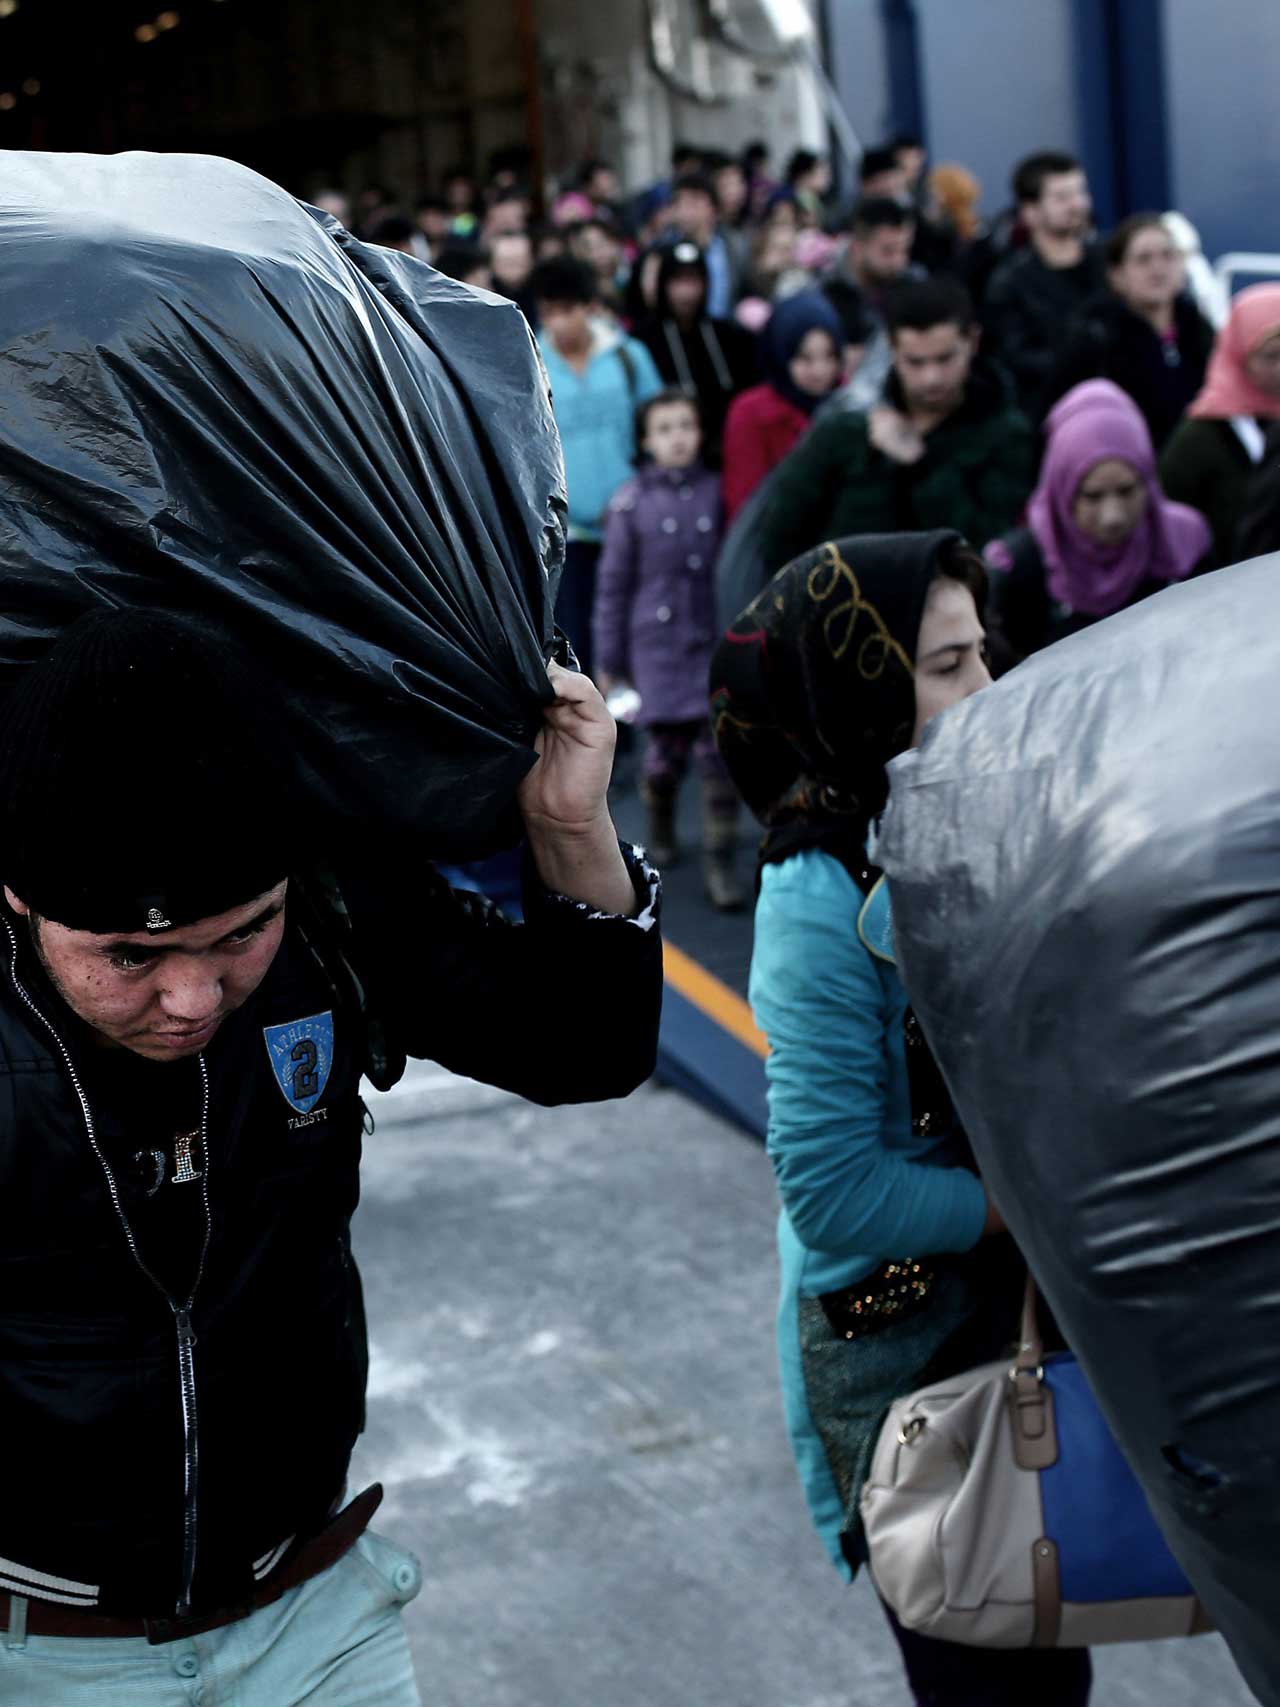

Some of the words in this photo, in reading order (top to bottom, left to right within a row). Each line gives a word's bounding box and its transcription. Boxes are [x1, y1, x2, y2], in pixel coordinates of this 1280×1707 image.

[272, 1023, 331, 1057] ATHLE
[291, 1039, 319, 1101] 2
[287, 1107, 328, 1130] VARISTY
